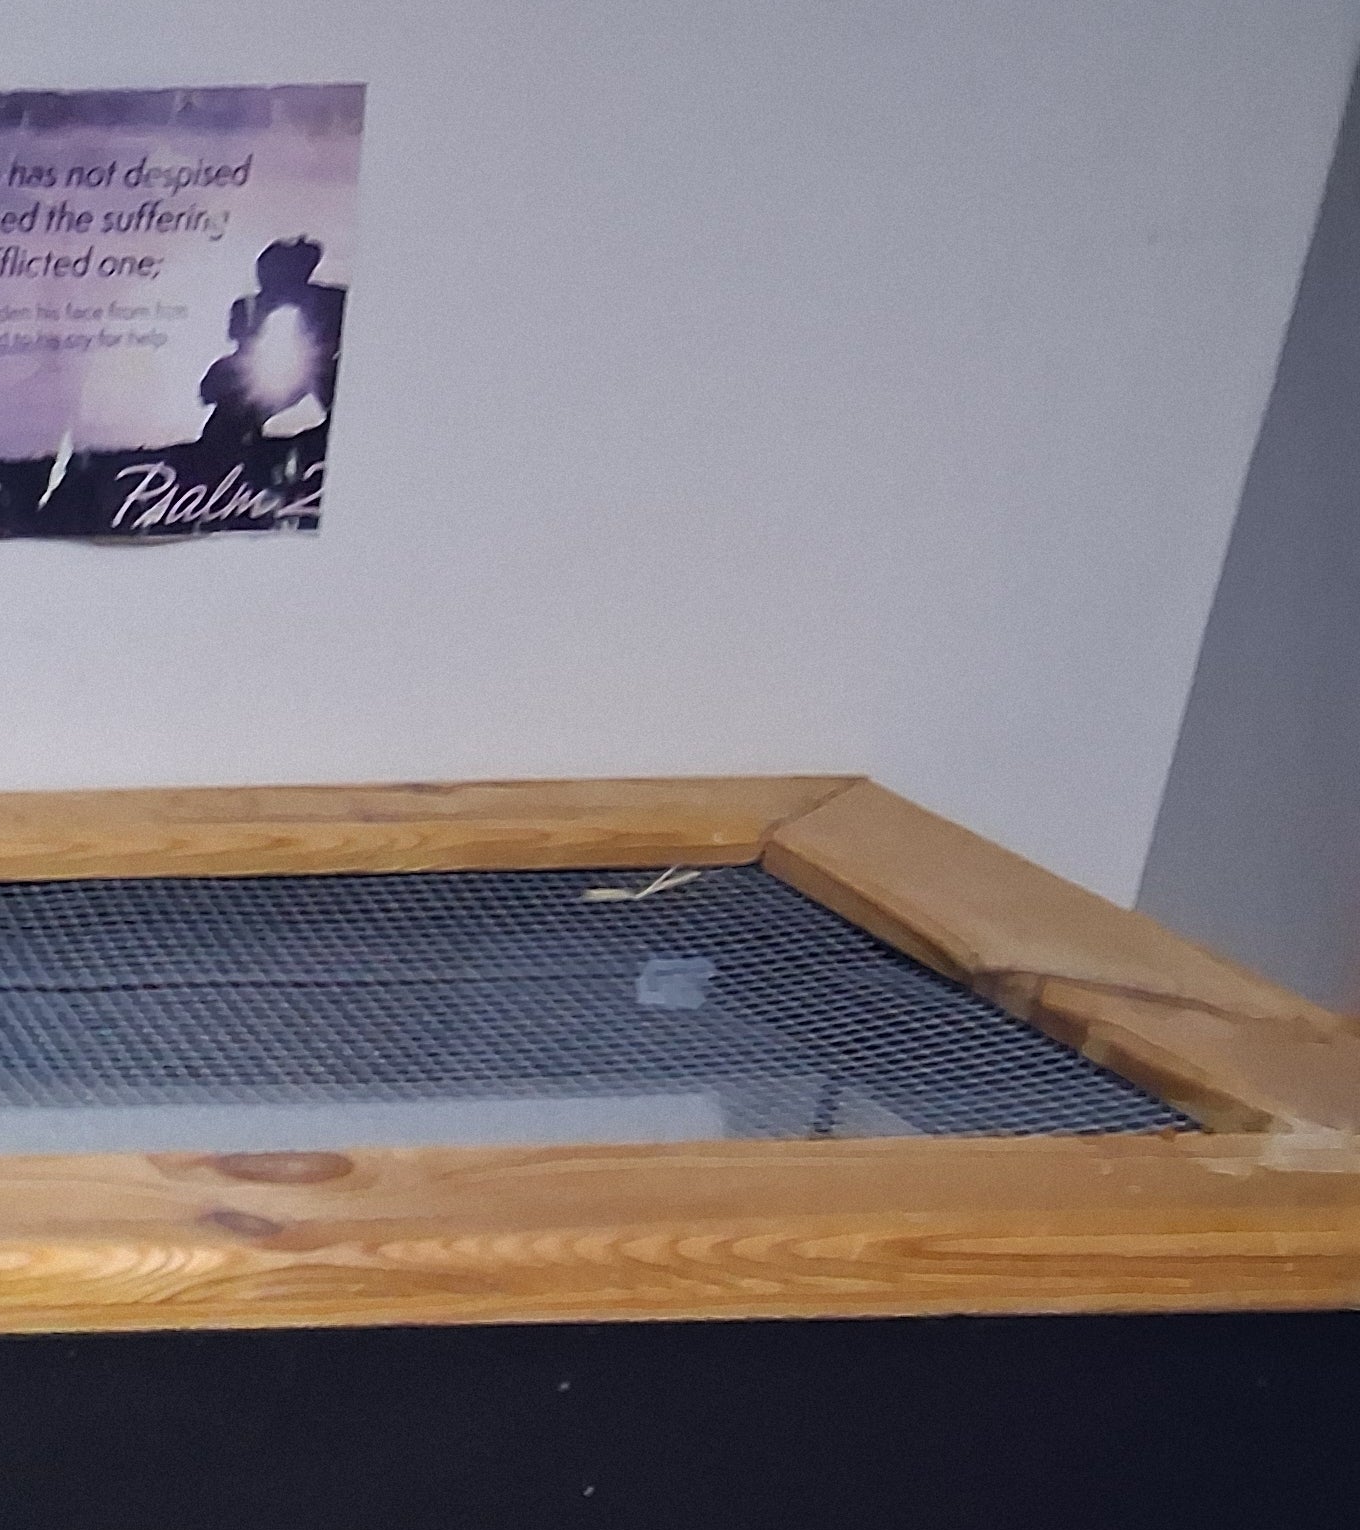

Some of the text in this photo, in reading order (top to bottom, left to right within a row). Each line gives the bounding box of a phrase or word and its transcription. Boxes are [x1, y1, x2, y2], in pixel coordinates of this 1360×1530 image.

[8, 158, 57, 188] has
[65, 160, 117, 188] not
[124, 153, 254, 197] despised
[45, 200, 94, 233] the
